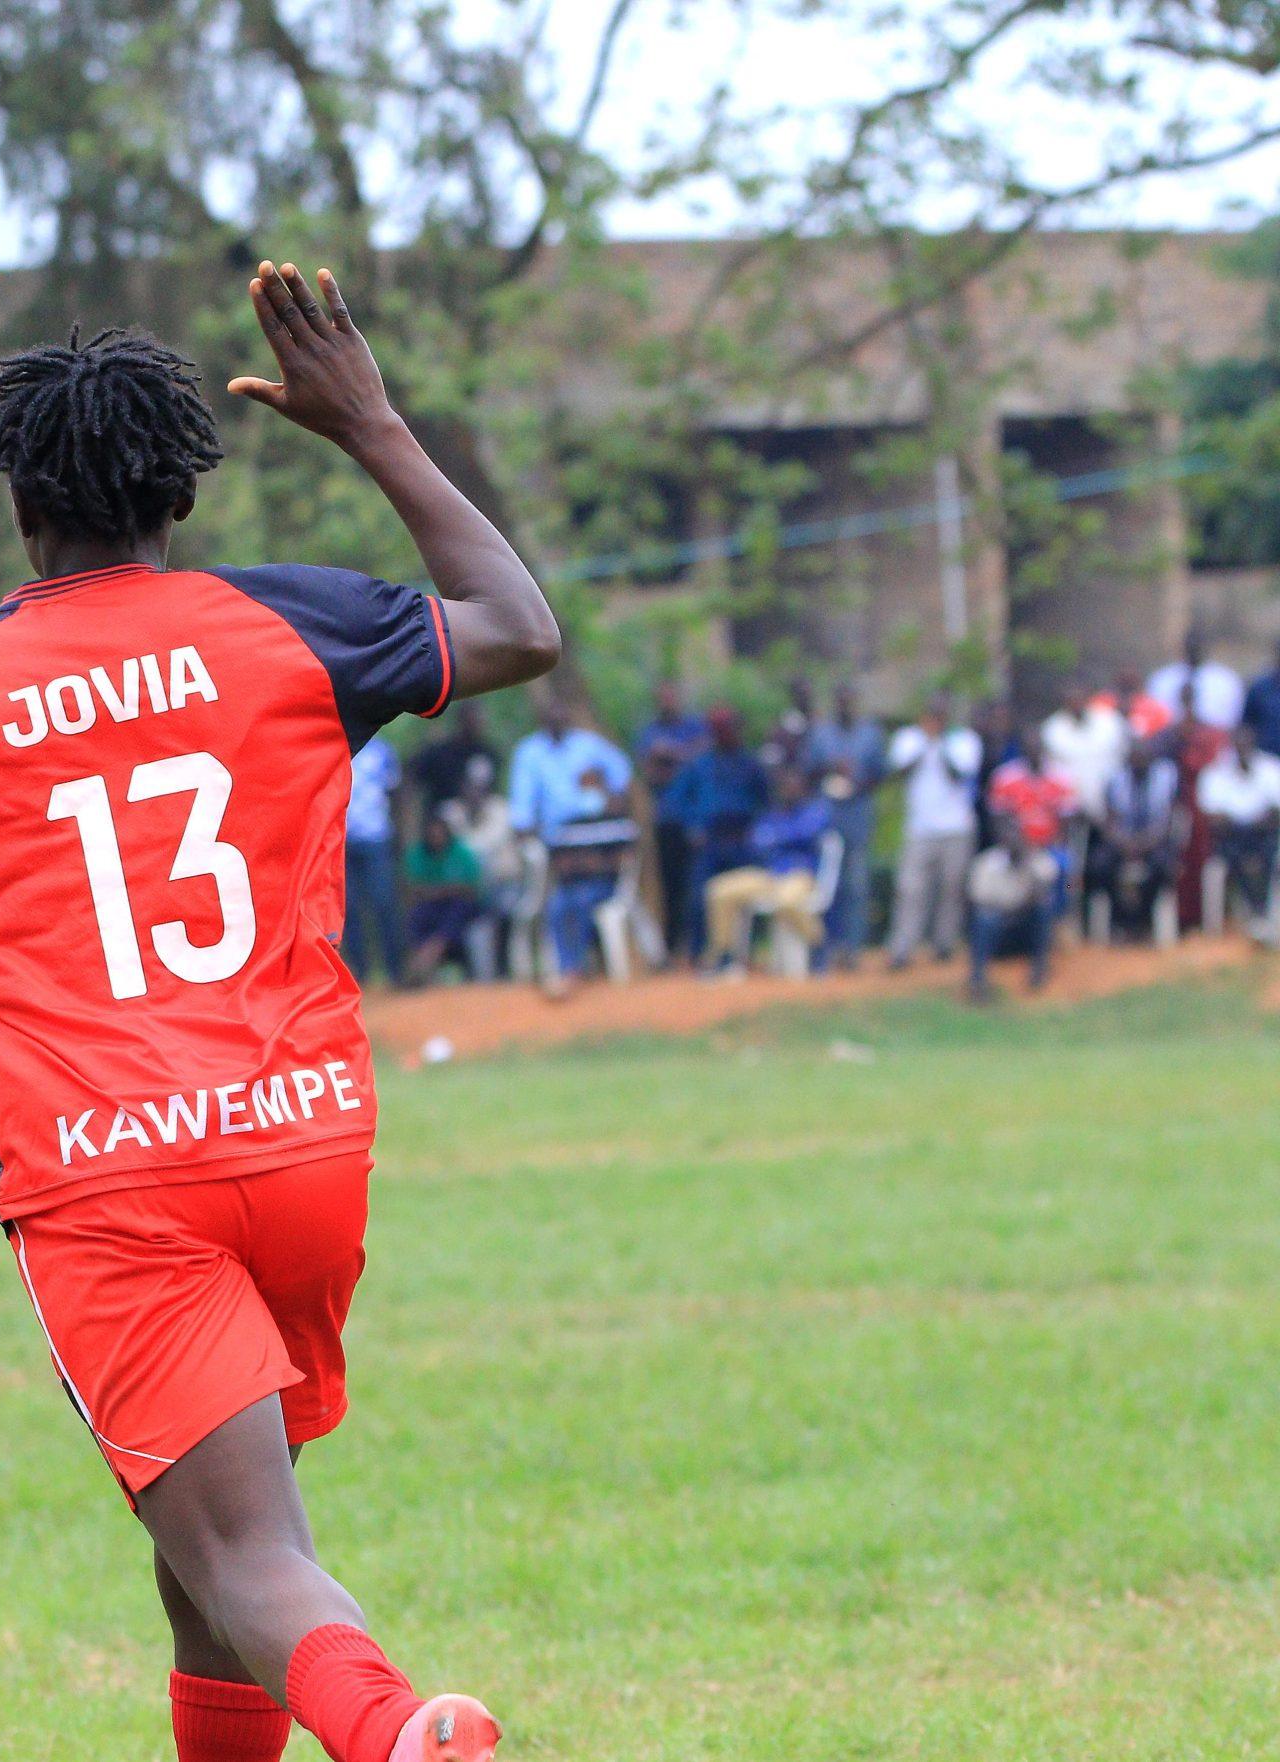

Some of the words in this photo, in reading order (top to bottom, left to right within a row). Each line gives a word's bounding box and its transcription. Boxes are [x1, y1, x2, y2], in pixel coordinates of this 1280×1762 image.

[2, 645, 219, 748] JOVIA
[46, 751, 257, 1000] 13
[56, 1060, 362, 1165] KAWEMPE
